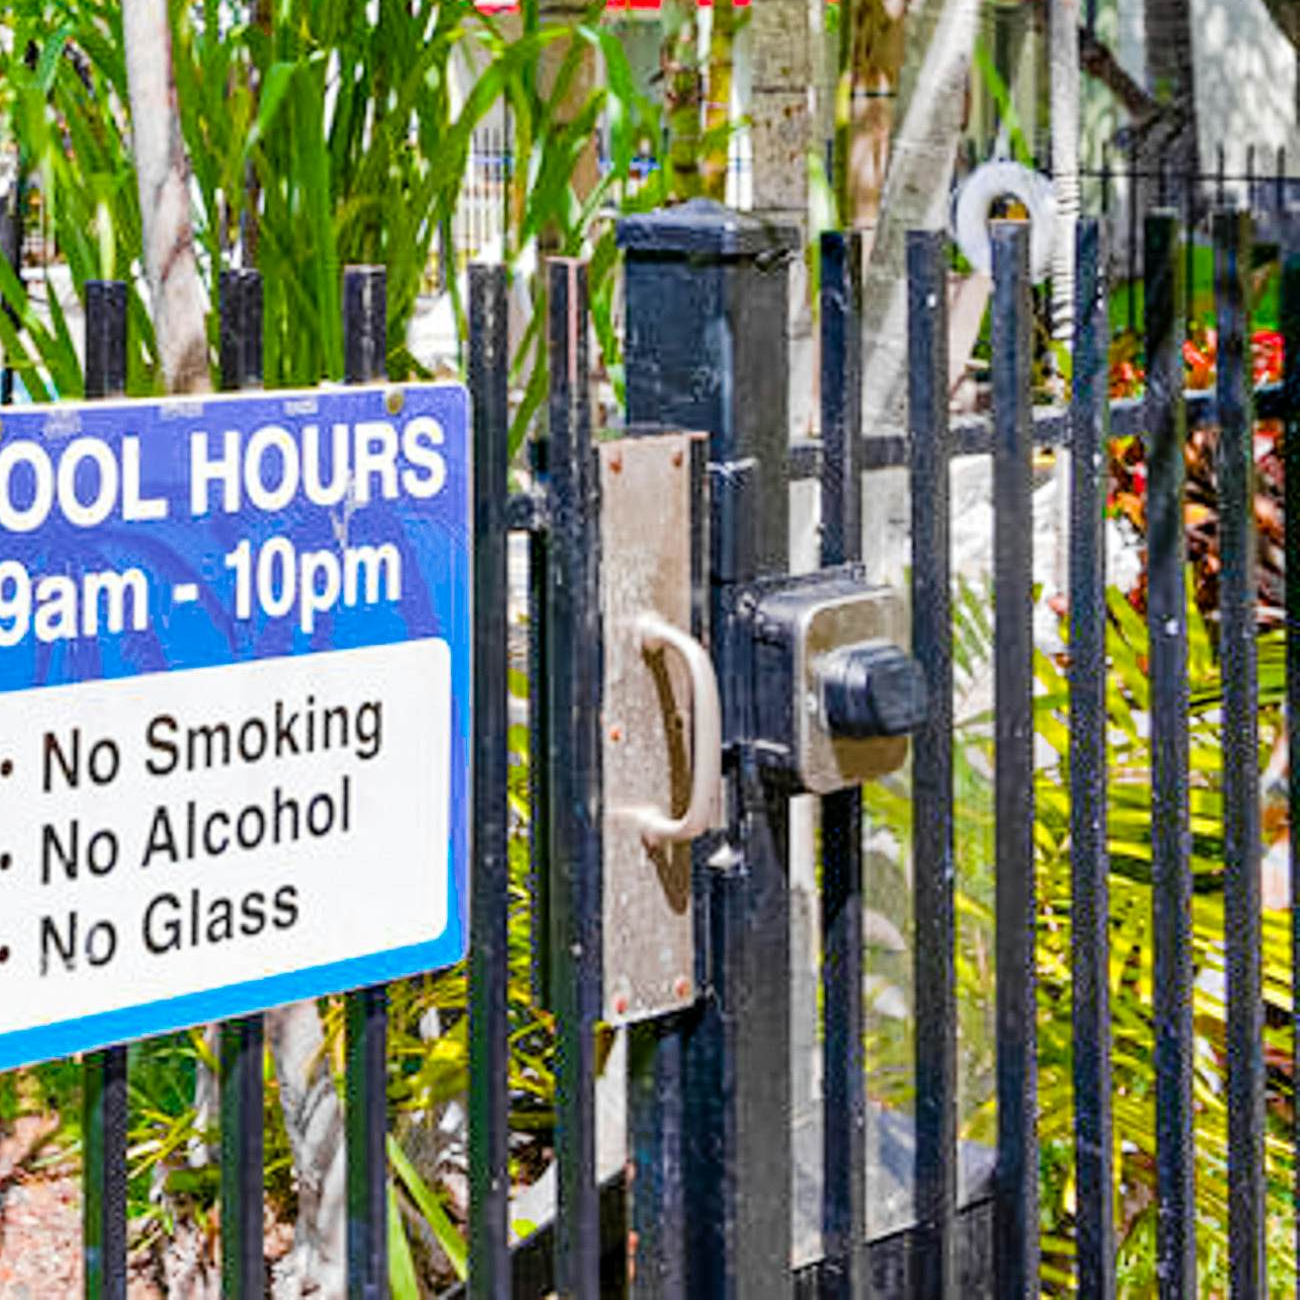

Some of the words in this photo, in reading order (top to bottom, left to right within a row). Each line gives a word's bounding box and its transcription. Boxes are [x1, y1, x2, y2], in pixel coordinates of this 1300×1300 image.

[190, 416, 447, 515] HOURS
[173, 583, 198, 602] -
[225, 536, 401, 634] 10pm
[41, 727, 121, 794] No
[144, 695, 383, 777] Smoking
[40, 818, 120, 886] No
[140, 774, 351, 869] Alcohol
[40, 910, 118, 977] No
[141, 883, 300, 956] Glass
